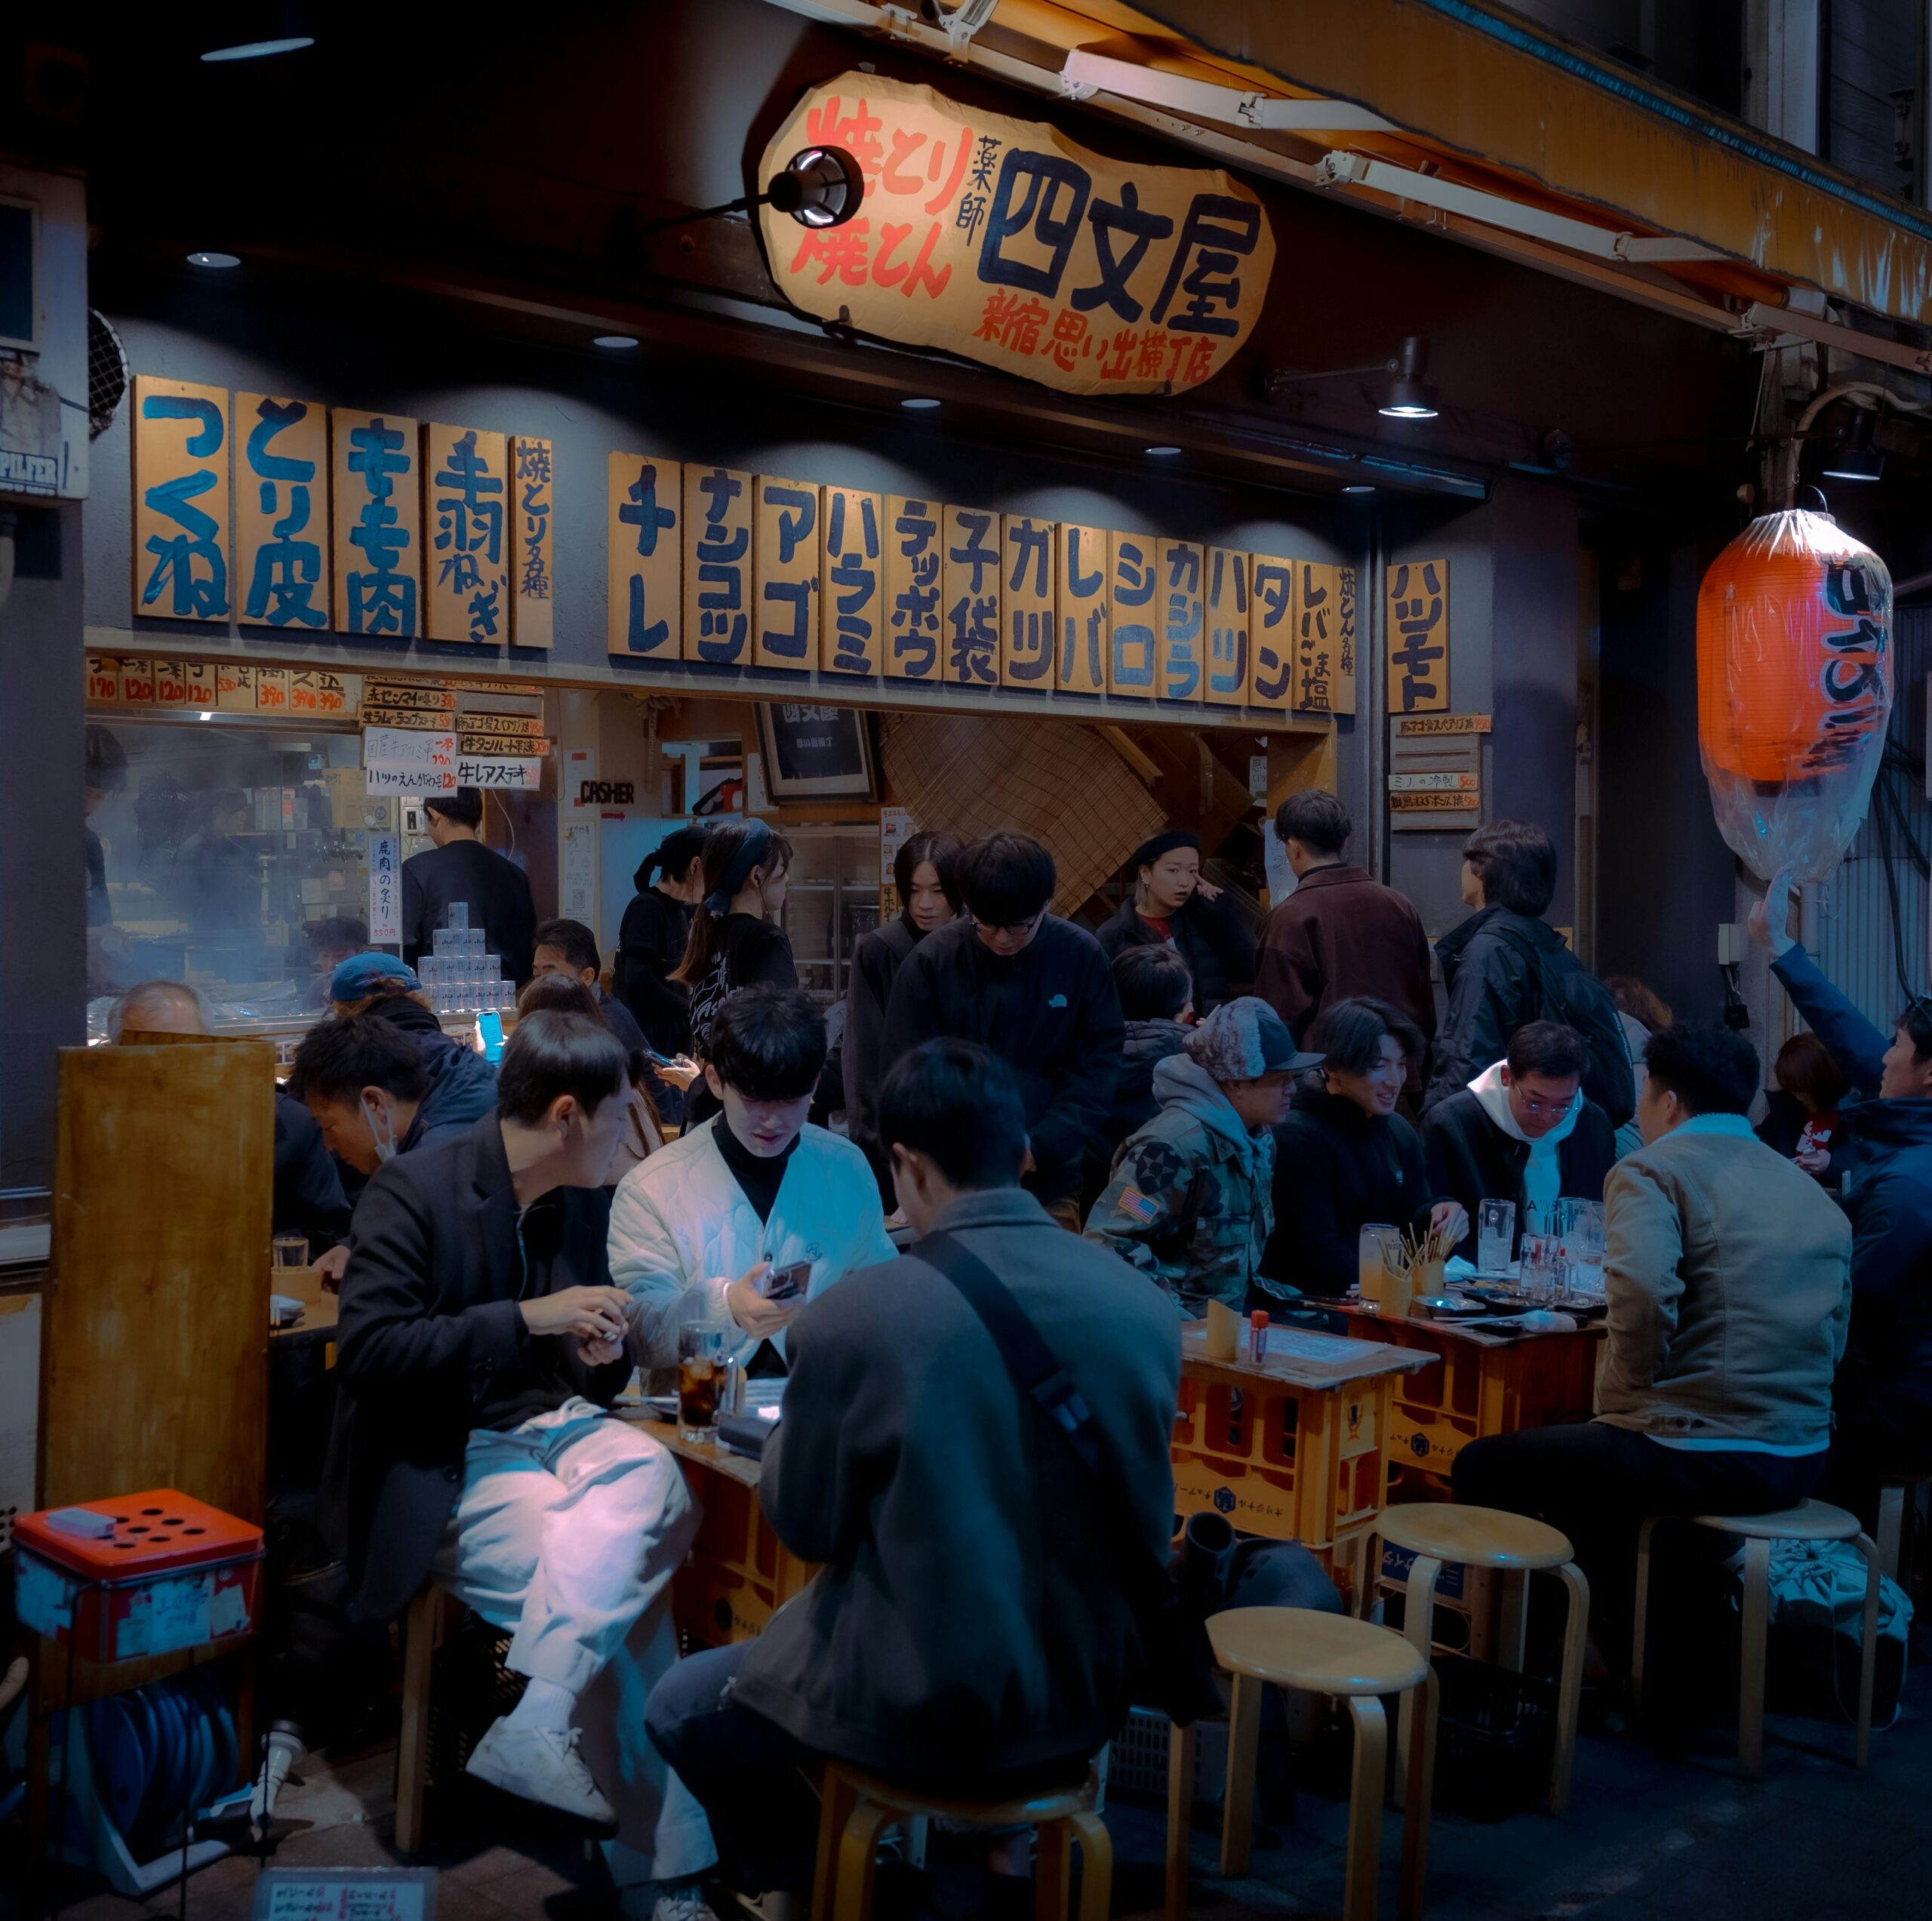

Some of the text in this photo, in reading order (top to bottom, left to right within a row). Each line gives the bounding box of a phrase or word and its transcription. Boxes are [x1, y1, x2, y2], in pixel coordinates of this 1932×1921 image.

[955, 135, 1002, 247] 薬師
[977, 147, 1262, 337] 四文屋
[972, 288, 1219, 385] 新宿思い出横丁店
[143, 396, 231, 616] つくね
[245, 398, 328, 628] とり皮
[347, 417, 417, 635] もも肉
[618, 464, 676, 653] チレ
[696, 469, 749, 663] ナンコツ
[761, 485, 820, 659] アゴ
[827, 492, 880, 675] ハラミ
[891, 500, 941, 677] テッポウ
[948, 511, 1000, 683] 子袋
[1009, 518, 1055, 680] ガツ
[1060, 527, 1109, 688] レバ
[1112, 542, 1156, 688] シロ
[1165, 543, 1203, 700] カシラ
[1211, 550, 1247, 694] ハツ
[1254, 563, 1291, 700] タン
[1390, 564, 1444, 711] ハツモト
[125, 678, 152, 700] 120
[159, 680, 185, 701] 120
[187, 683, 211, 703] 120
[260, 684, 285, 707] 390
[374, 928, 396, 937] 550円
[377, 839, 391, 920] 鹿肉の炙り
